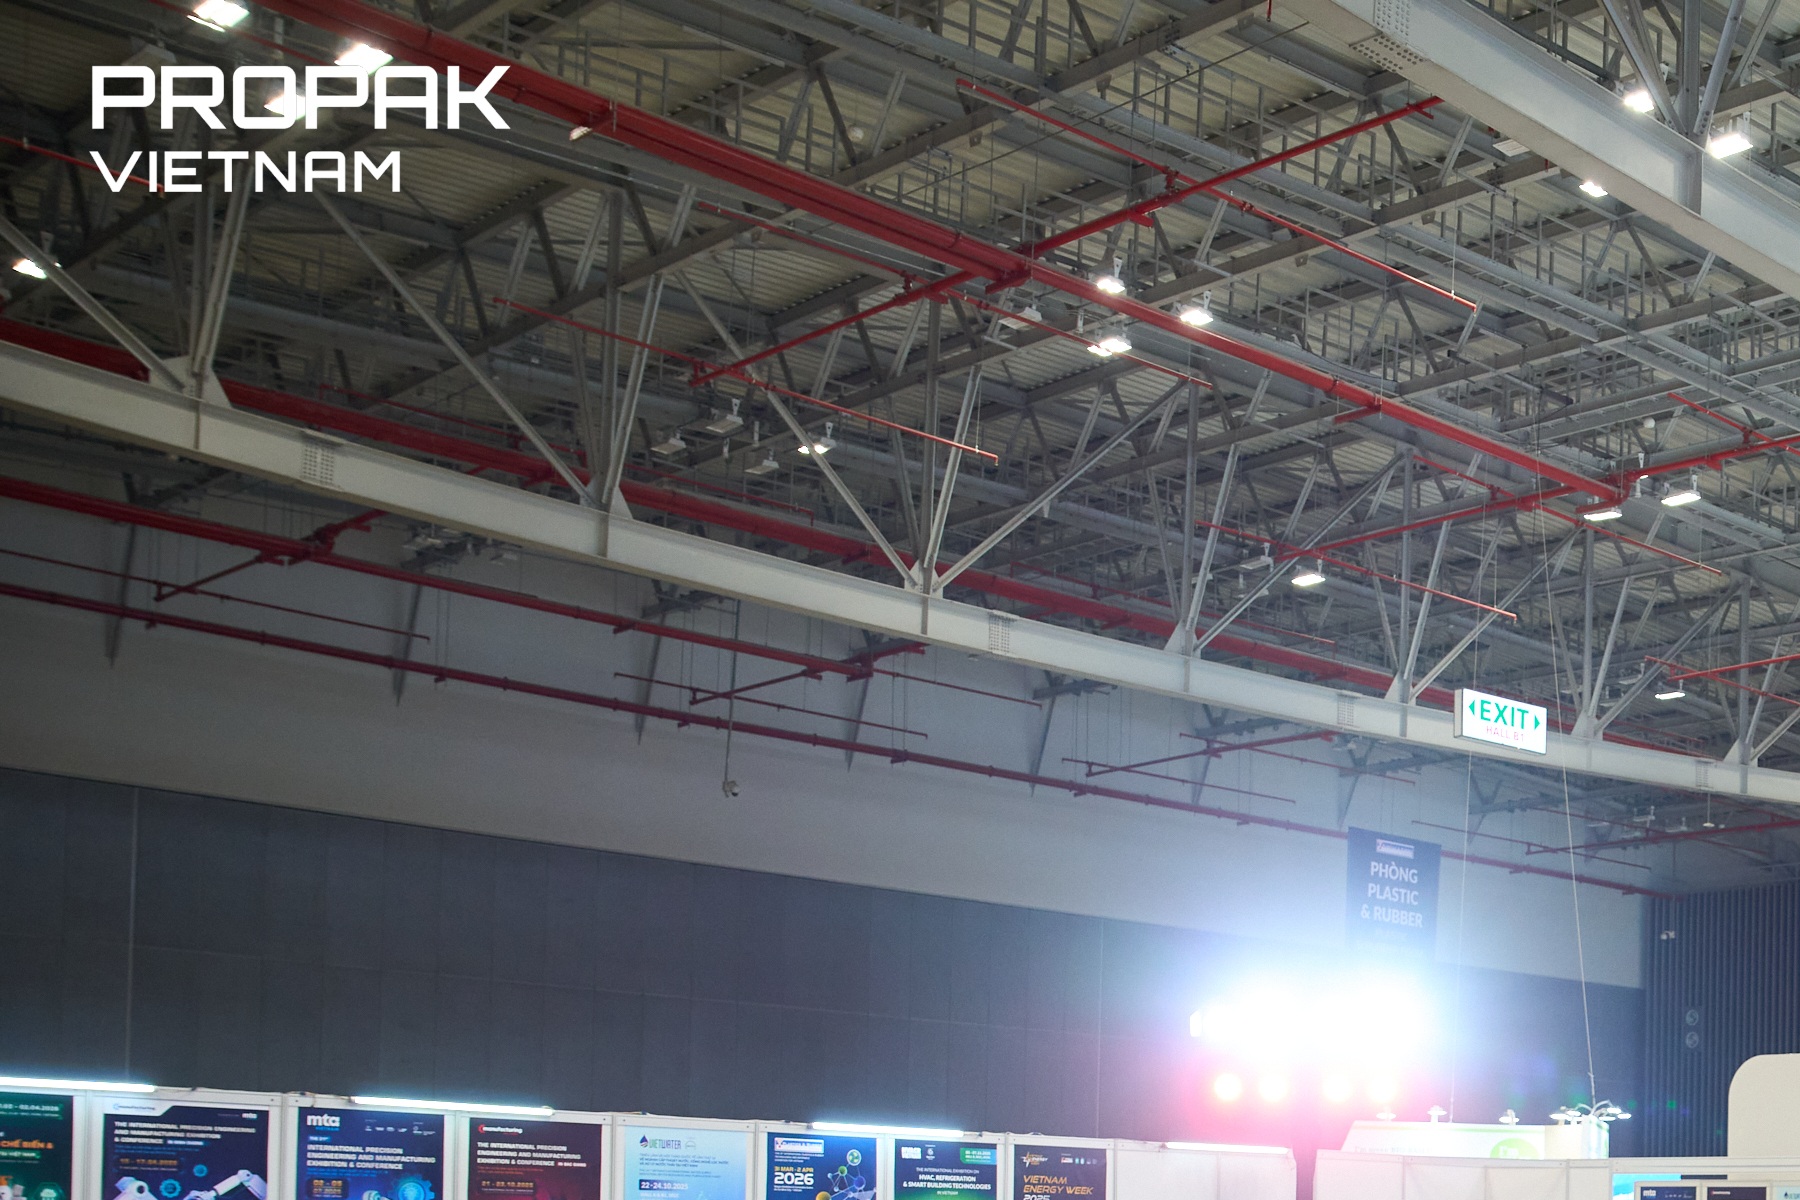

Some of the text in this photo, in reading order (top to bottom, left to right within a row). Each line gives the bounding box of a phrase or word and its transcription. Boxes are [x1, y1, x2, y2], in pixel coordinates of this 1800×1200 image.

[1480, 699, 1529, 730] EXIT
[1486, 725, 1525, 742] HALL B1
[1370, 861, 1418, 883] PHÒNG
[1367, 882, 1419, 905] PLASTIC
[1360, 904, 1423, 928] & RUBBER
[306, 1113, 340, 1127] mta
[490, 1142, 536, 1150] INTERNATIONAL
[307, 1152, 357, 1160] ENGINEERING
[375, 1155, 436, 1163] MANUFACTURING
[532, 1152, 581, 1160] MANUFACTURING
[356, 1162, 403, 1170] CONFERENCE
[774, 1172, 814, 1185] 2026
[1023, 1175, 1067, 1185] VIETNAM
[1023, 1184, 1094, 1195] ENERGY WEEK
